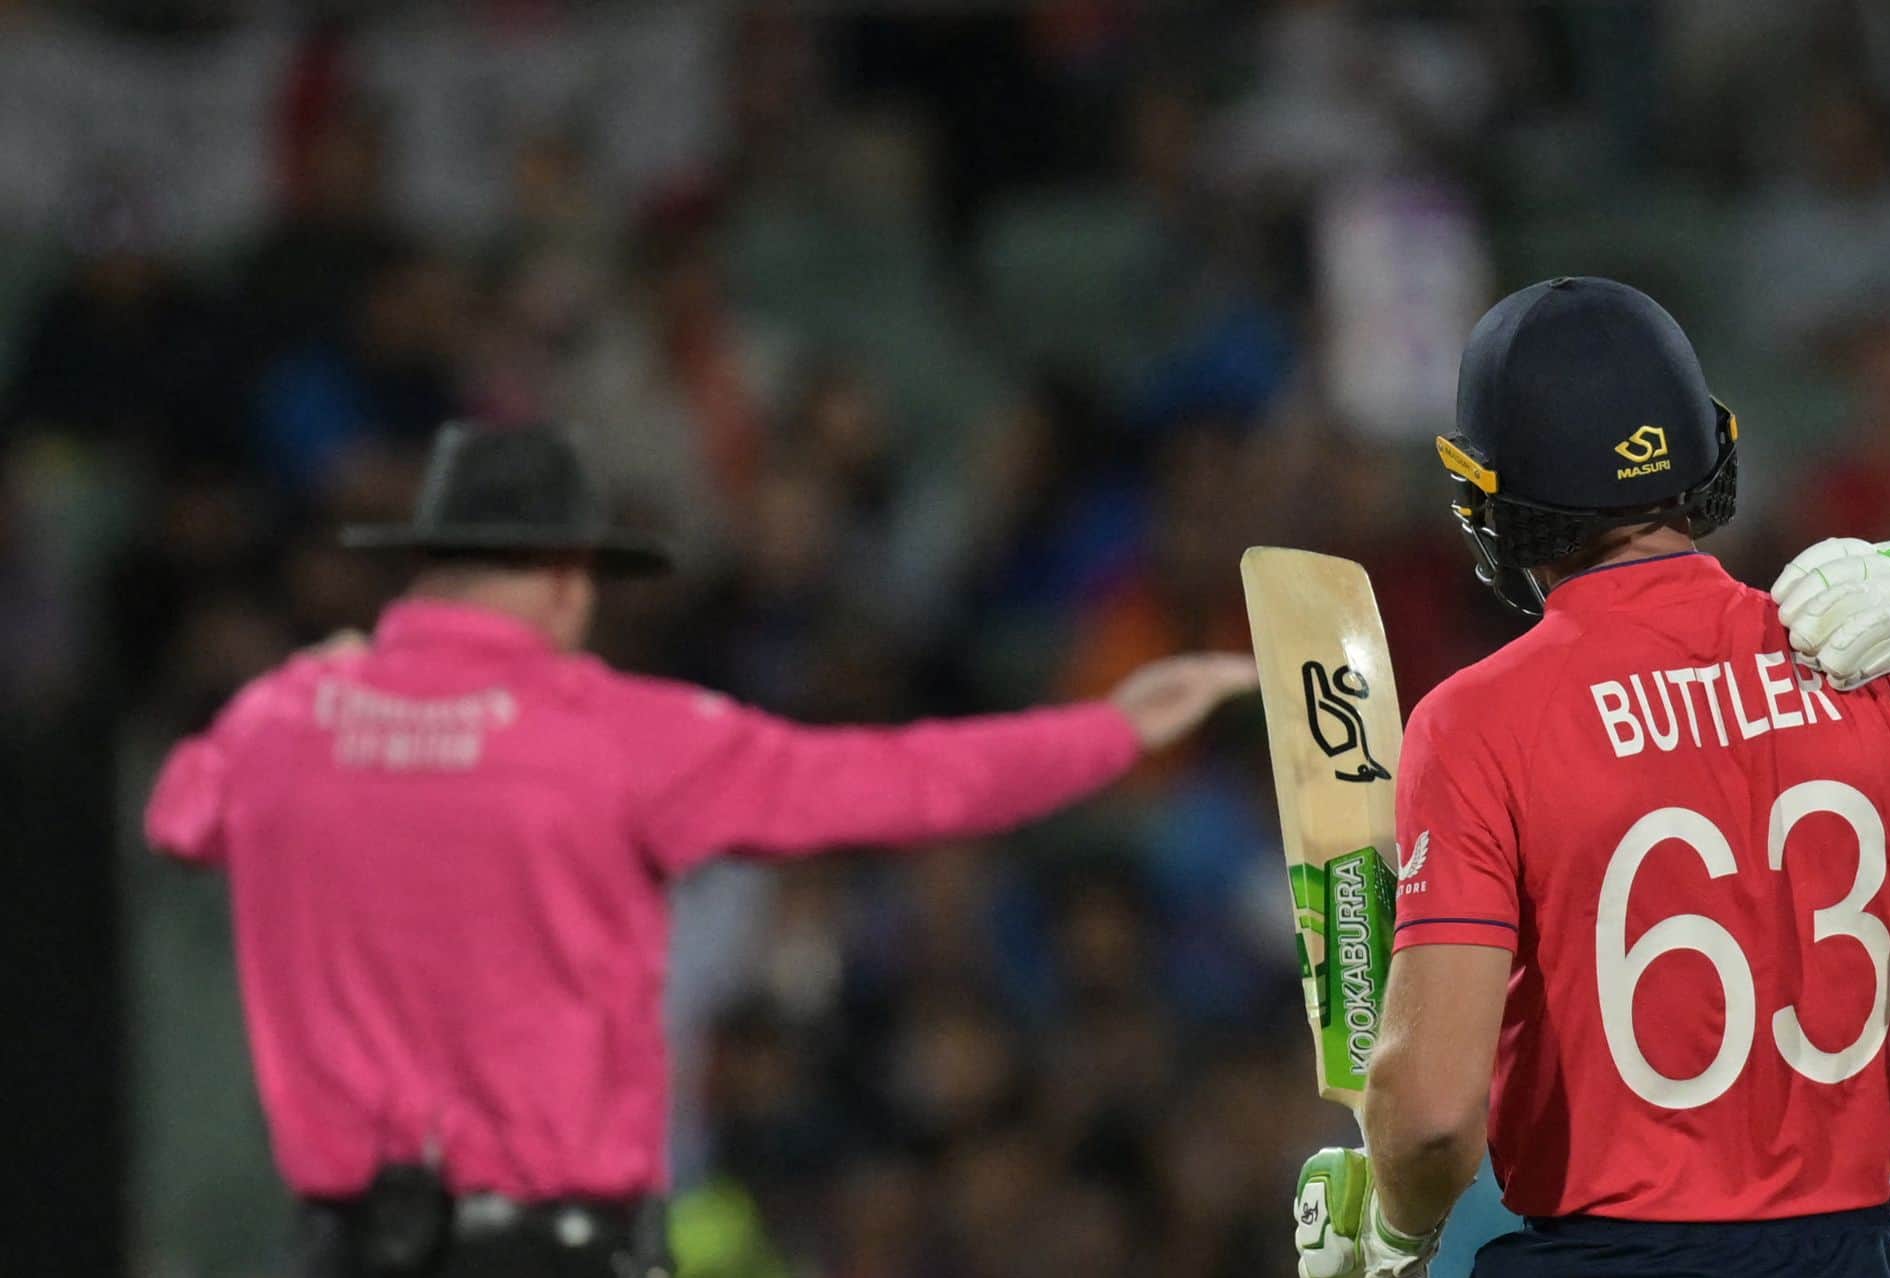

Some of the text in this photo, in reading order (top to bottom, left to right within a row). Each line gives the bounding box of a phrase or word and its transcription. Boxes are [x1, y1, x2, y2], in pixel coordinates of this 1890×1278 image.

[1617, 459, 1671, 480] MASURI
[1590, 650, 1842, 758] BUTTLER
[1333, 856, 1378, 1076] KOOKABURRA
